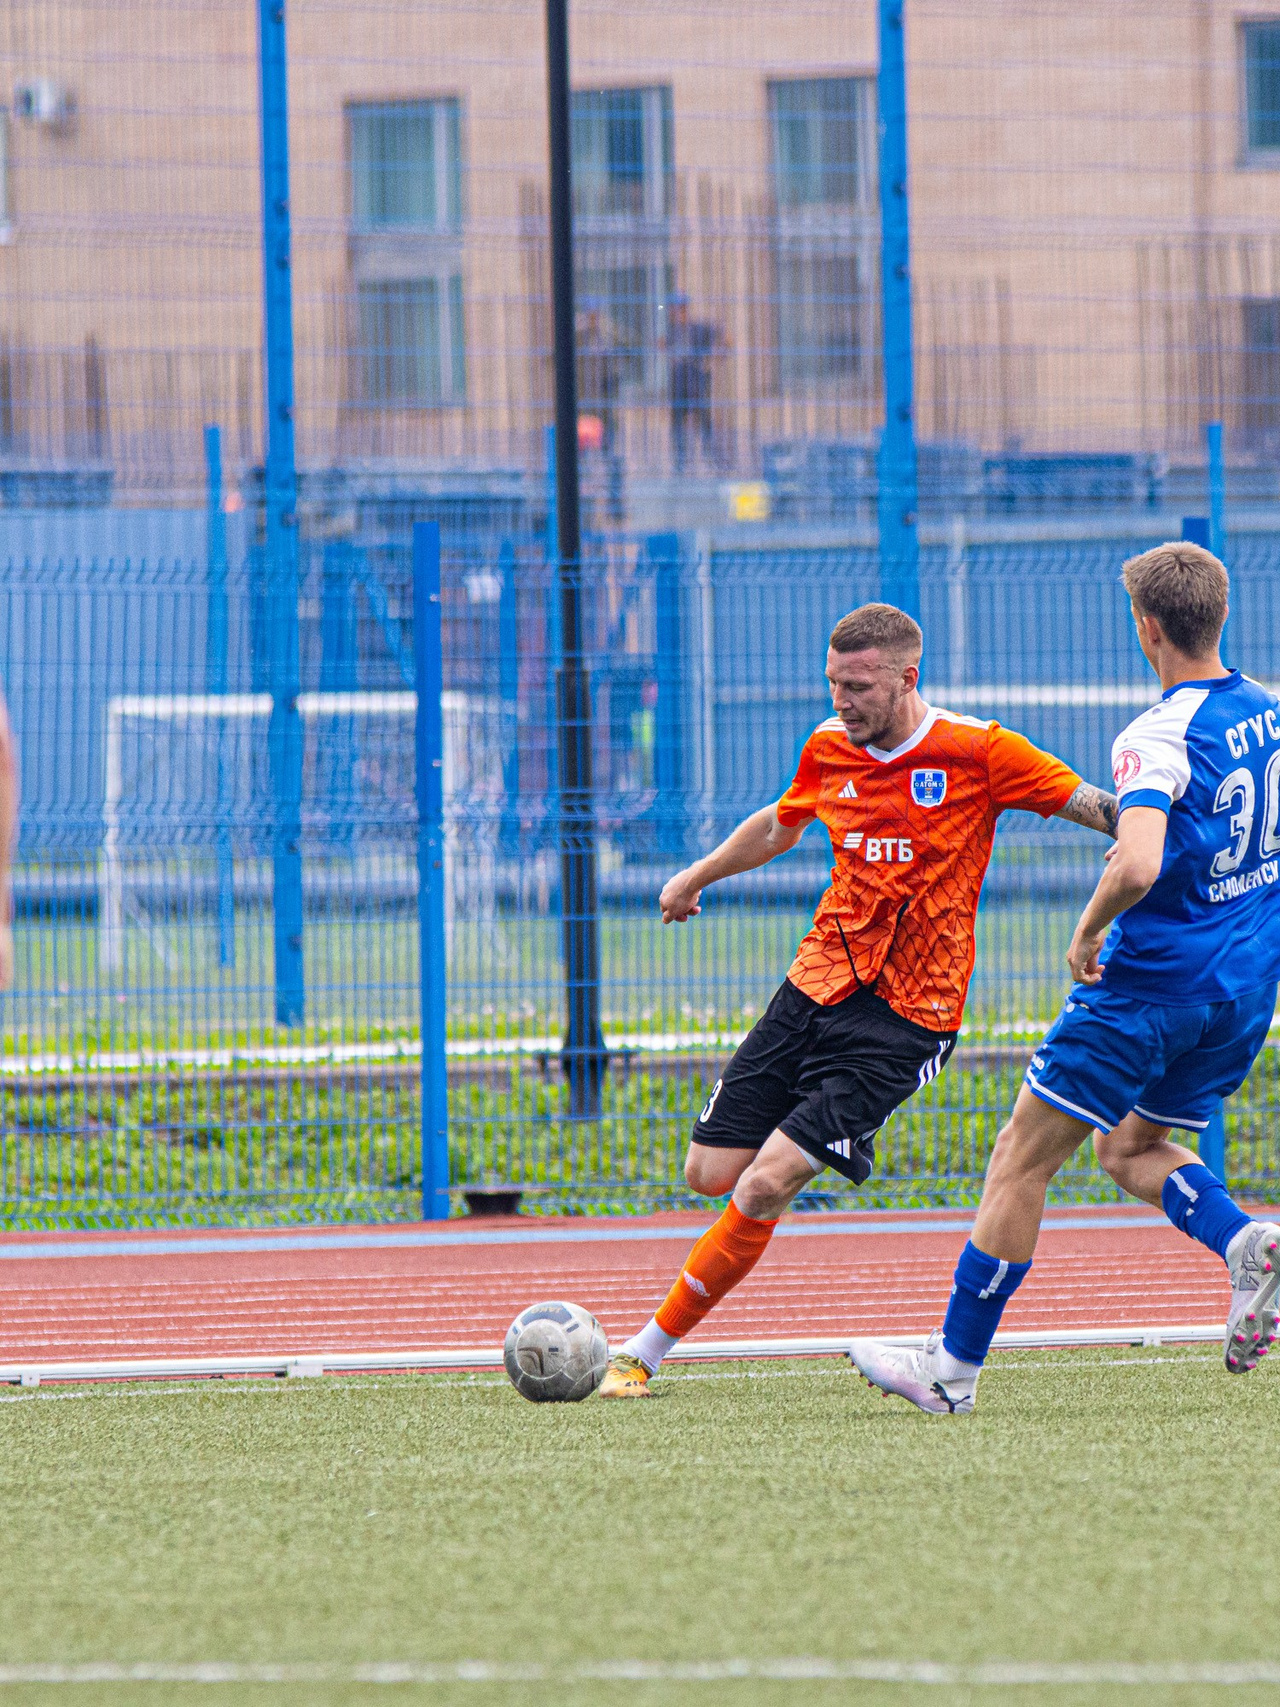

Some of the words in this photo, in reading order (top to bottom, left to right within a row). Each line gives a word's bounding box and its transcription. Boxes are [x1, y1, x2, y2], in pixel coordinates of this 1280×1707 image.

[919, 780, 938, 788] АТОМ
[865, 838, 914, 862] ВТБ
[700, 1079, 723, 1123] 3
